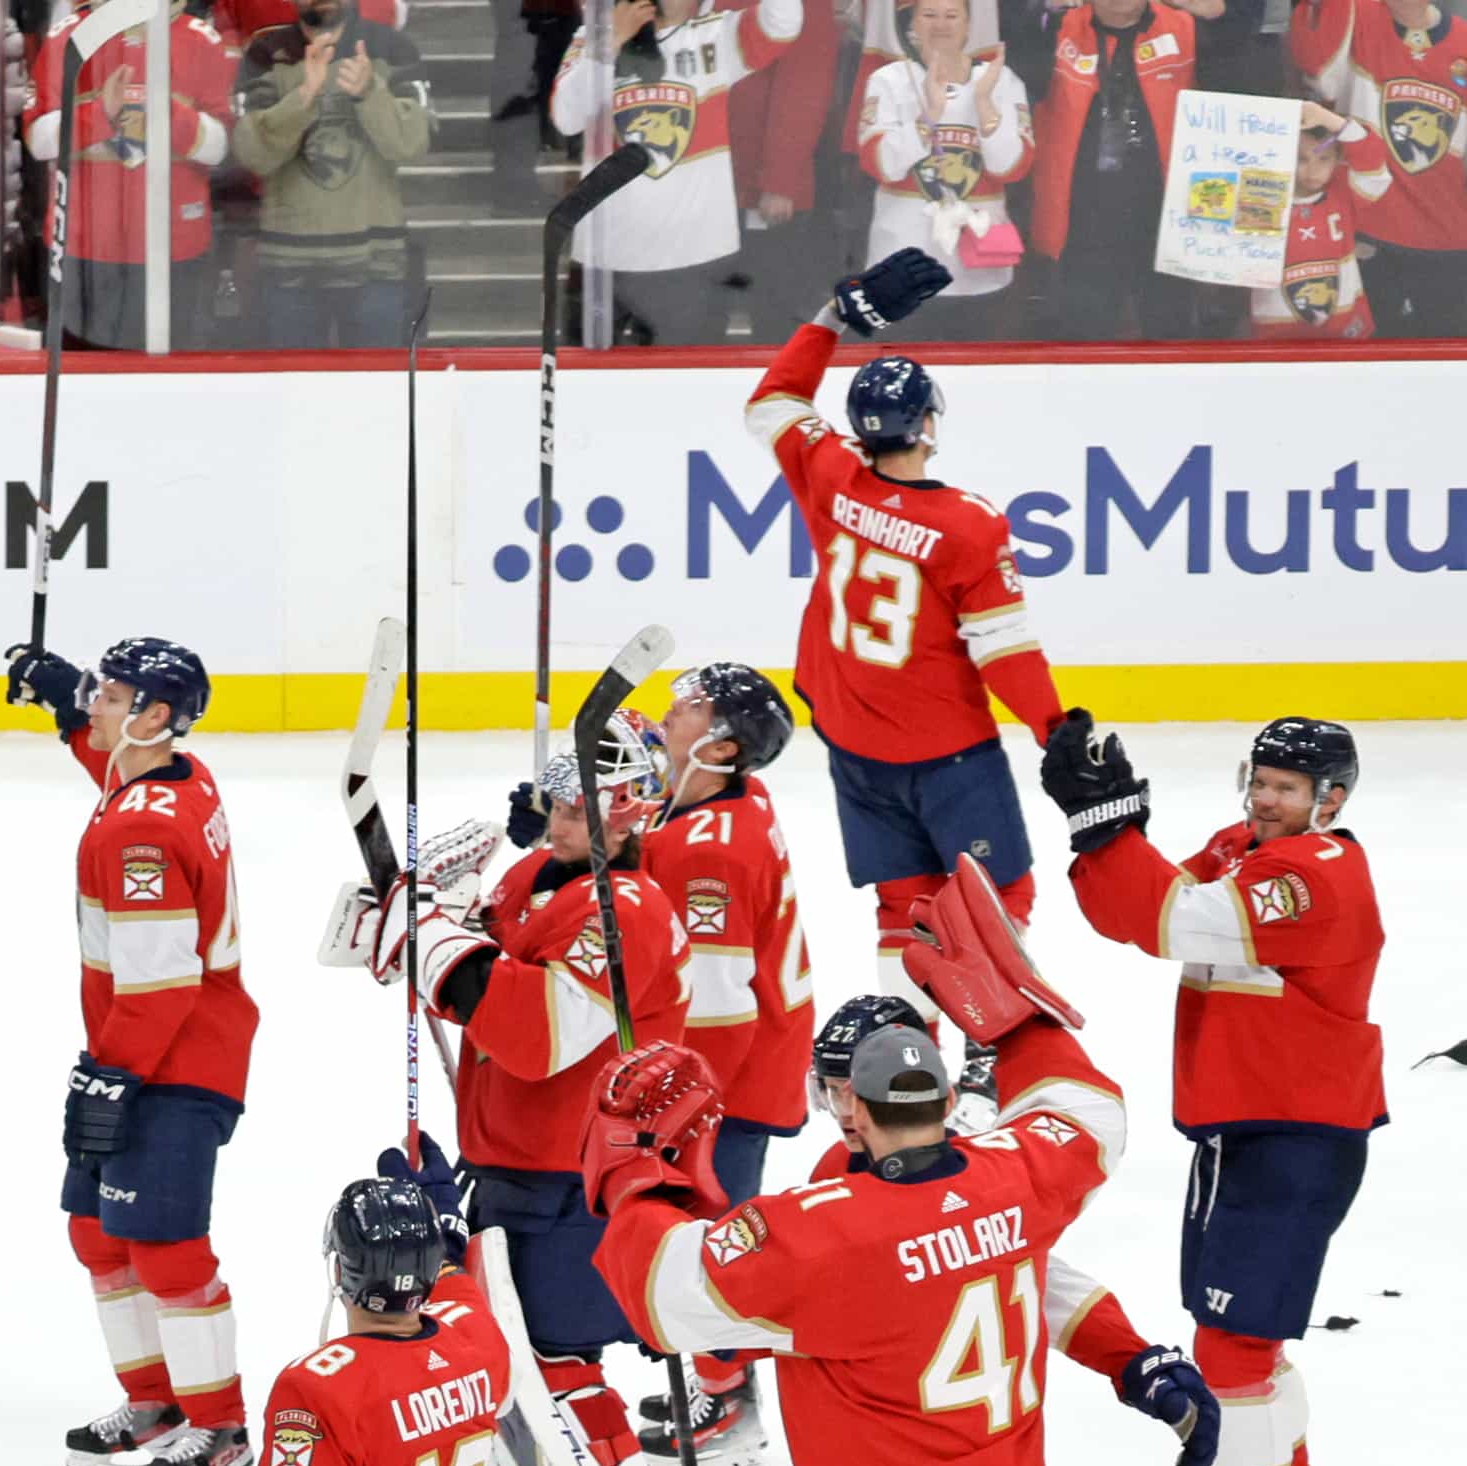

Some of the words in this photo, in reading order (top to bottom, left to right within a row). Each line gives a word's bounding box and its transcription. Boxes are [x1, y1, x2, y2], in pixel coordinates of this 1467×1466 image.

[616, 85, 689, 106] FLORIDA
[1389, 83, 1455, 109] PANTHERS
[1184, 103, 1227, 134] Will
[49, 169, 67, 283] CCM
[539, 352, 556, 466] CCM
[861, 414, 883, 432] 13
[688, 445, 1467, 579] MsMutu
[833, 492, 943, 564] REINHART
[824, 531, 923, 671] 13
[118, 781, 178, 819] 42
[685, 808, 734, 846] 21
[828, 1024, 858, 1044] 27
[67, 1069, 126, 1101] CM
[896, 1206, 1028, 1285] STOLARZ
[394, 1274, 415, 1292] 18
[918, 1257, 1040, 1436] 41
[391, 1367, 497, 1442] LORENTZ
